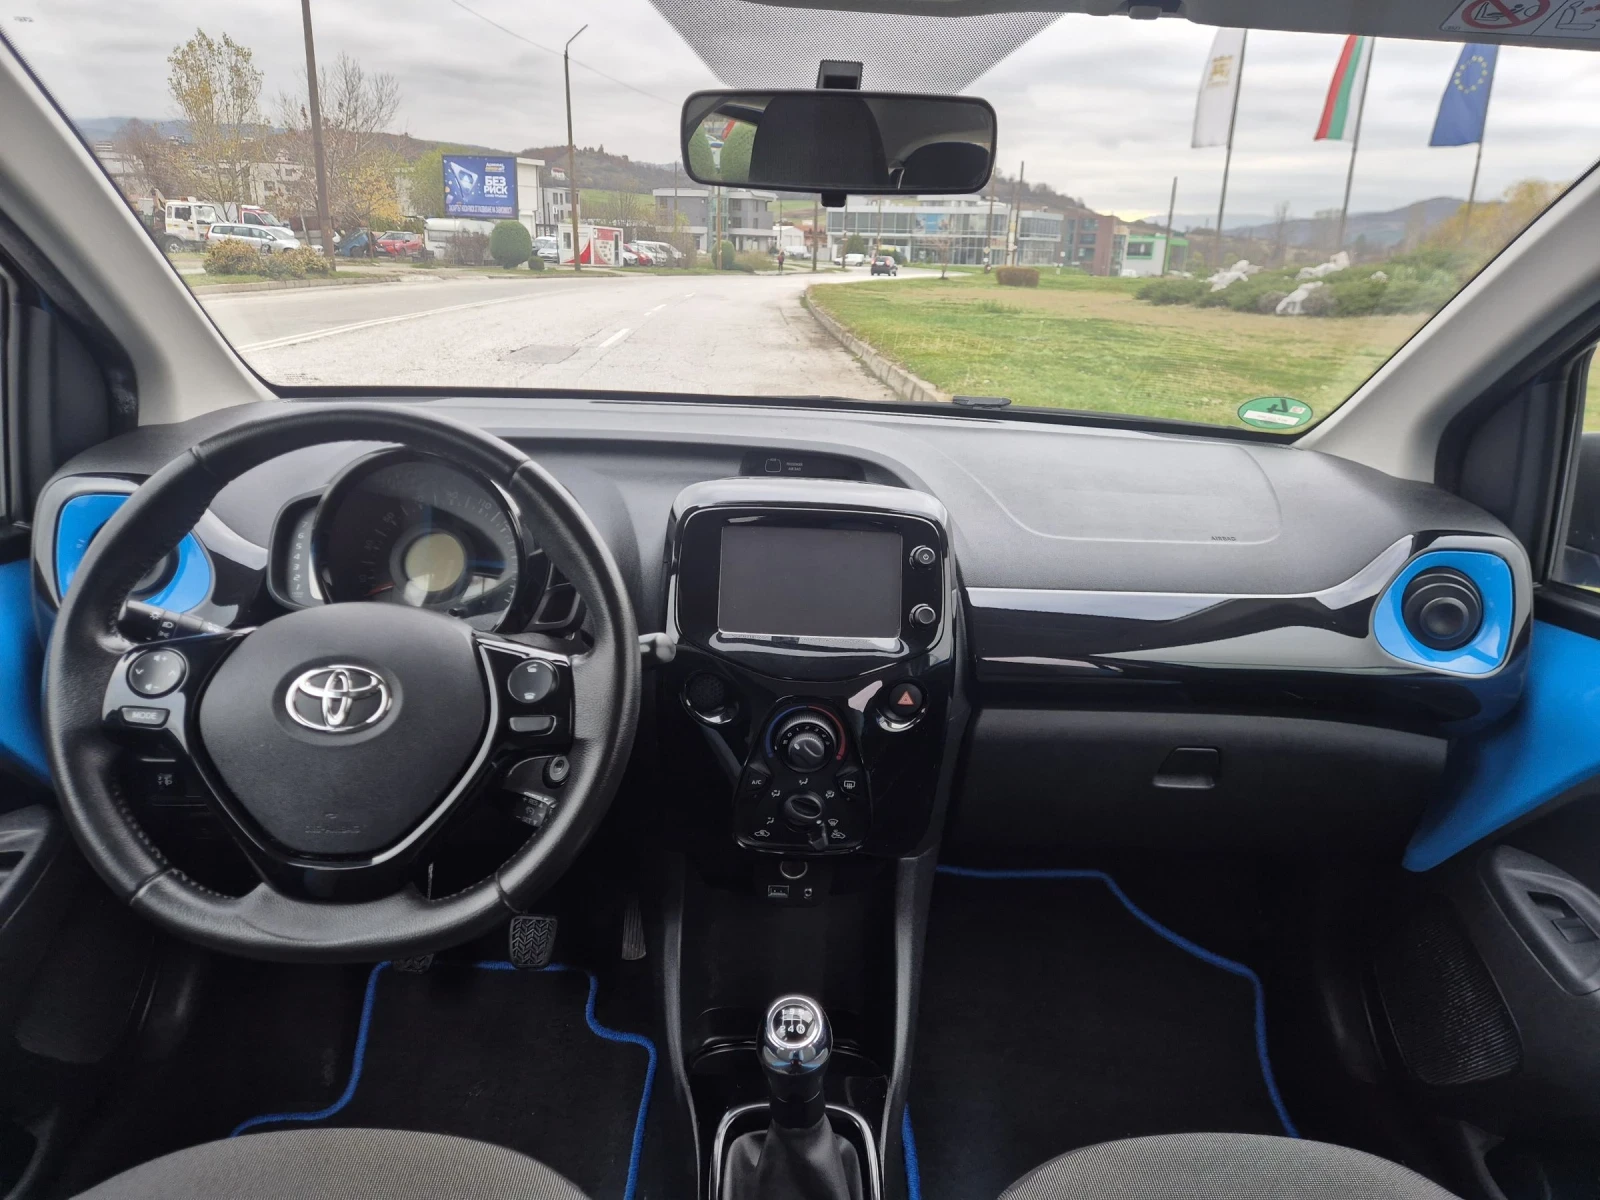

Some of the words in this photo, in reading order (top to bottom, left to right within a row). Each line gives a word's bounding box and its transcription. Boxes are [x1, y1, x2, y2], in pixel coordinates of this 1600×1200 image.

[484, 176, 506, 186] БЕЗ
[484, 186, 508, 195] РИСК
[132, 711, 157, 720] MODE
